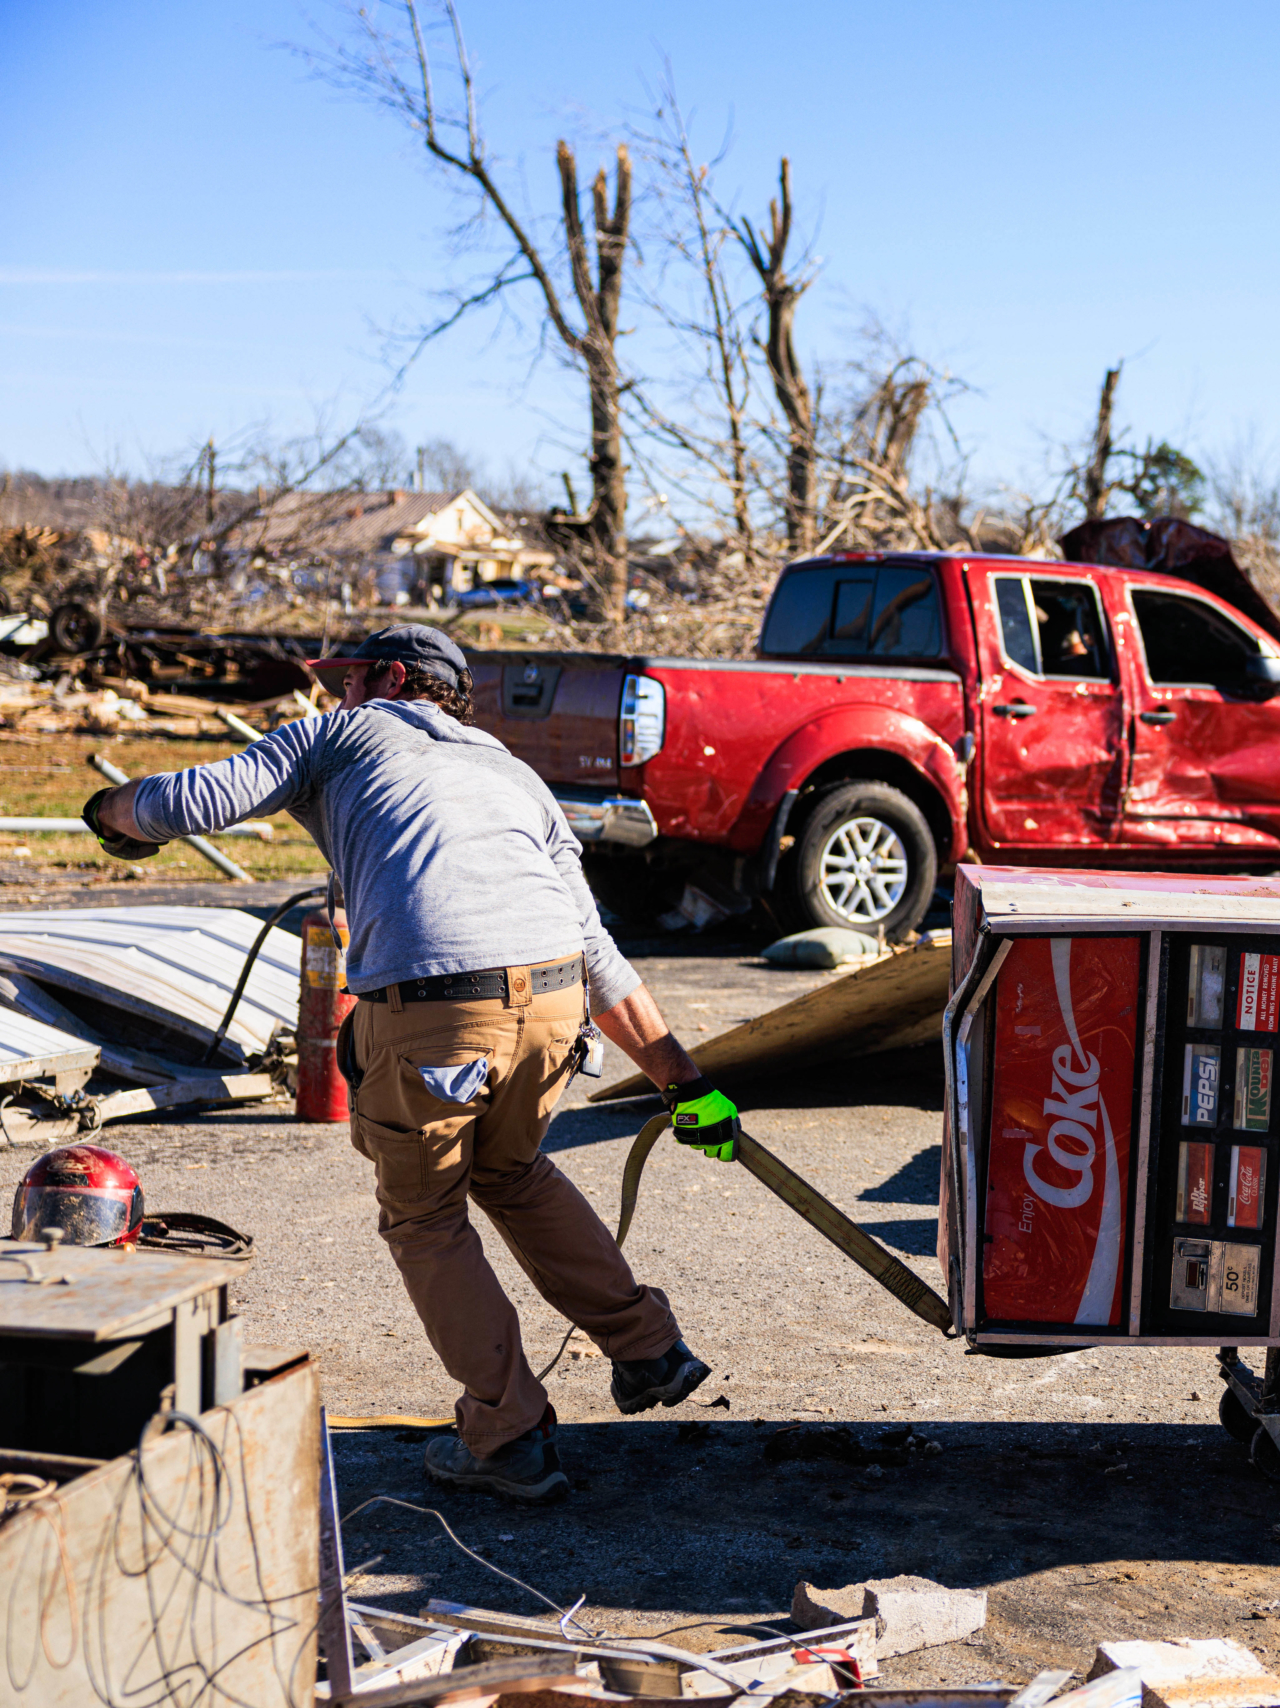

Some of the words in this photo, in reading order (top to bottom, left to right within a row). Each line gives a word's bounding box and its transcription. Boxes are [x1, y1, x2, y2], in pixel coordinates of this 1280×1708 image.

[1245, 970, 1256, 1014] NOTICE
[1197, 1056, 1216, 1122] PEPSI
[1023, 1045, 1100, 1208] Coke
[1019, 1193, 1036, 1233] Enjoy
[1191, 1187, 1199, 1201] Dr
[1193, 1178, 1207, 1212] Pepper
